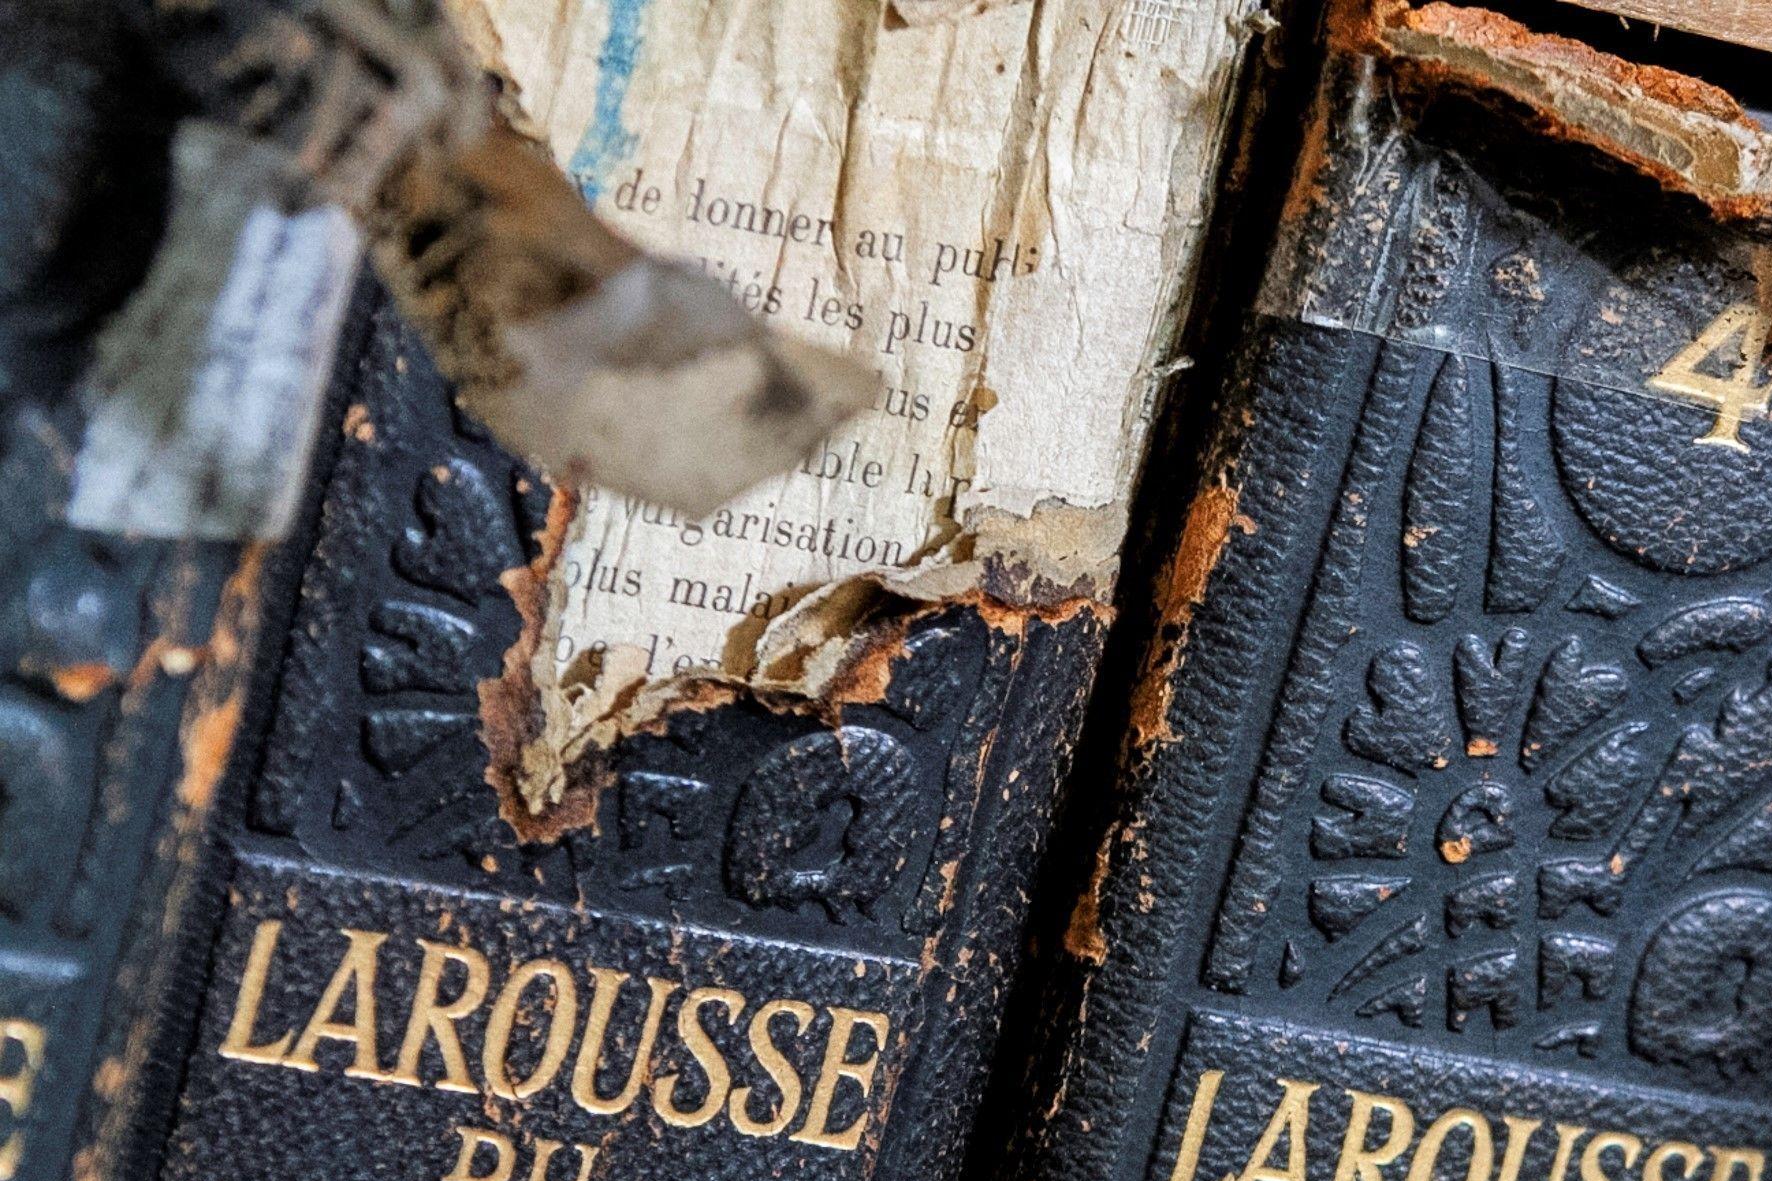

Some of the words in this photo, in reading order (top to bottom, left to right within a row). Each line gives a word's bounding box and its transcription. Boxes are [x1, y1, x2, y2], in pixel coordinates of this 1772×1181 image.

[613, 167, 662, 215] de
[854, 229, 903, 263] au
[803, 276, 864, 331] les
[880, 300, 977, 355] plus
[218, 919, 890, 1151] LAROUSSE
